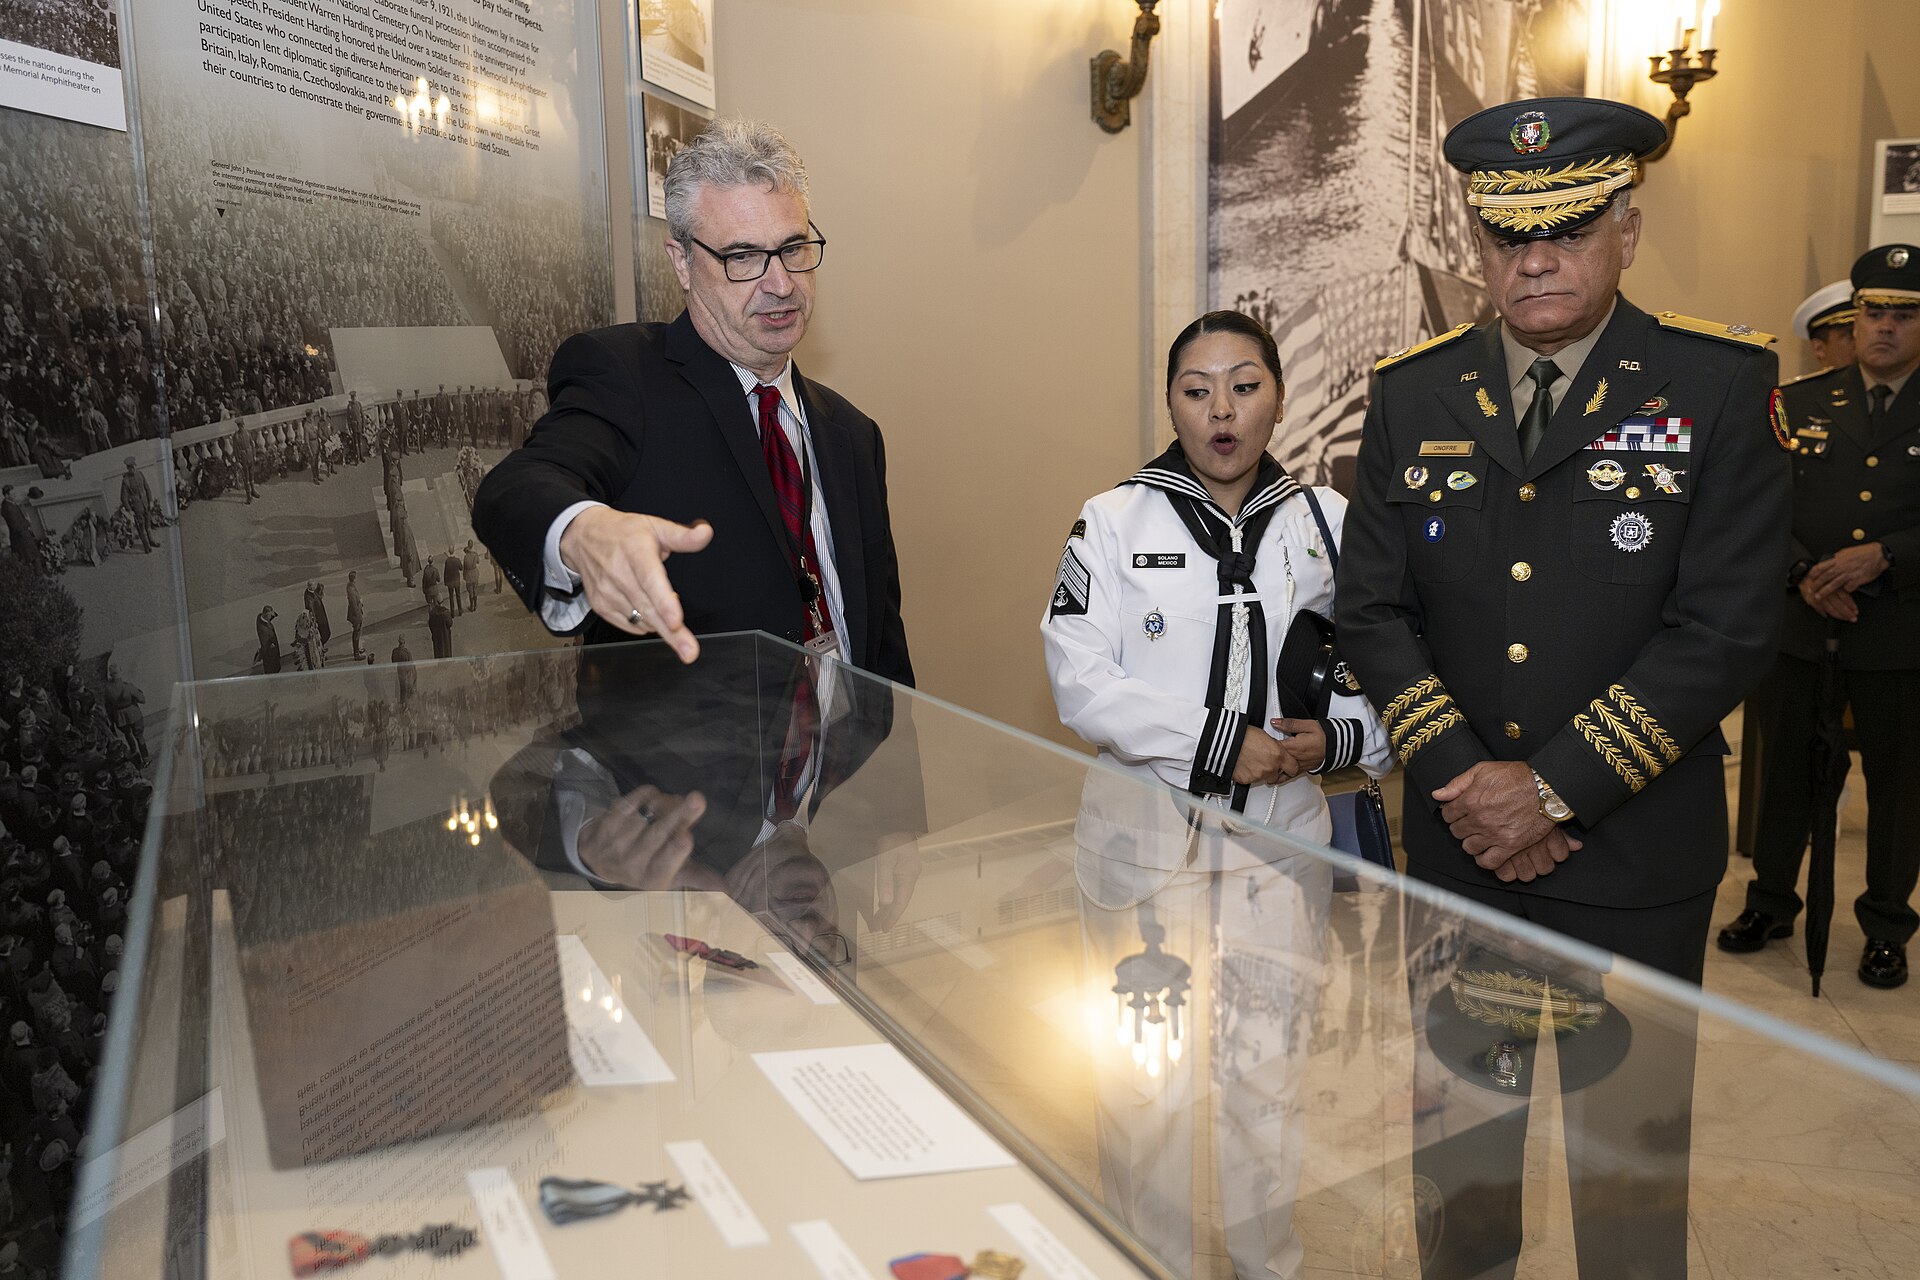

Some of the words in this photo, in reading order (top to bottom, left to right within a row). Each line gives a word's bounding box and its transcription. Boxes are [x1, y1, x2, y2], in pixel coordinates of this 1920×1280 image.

[262, 2, 306, 28] President
[306, 18, 341, 43] Harding
[342, 31, 376, 53] honored
[378, 44, 390, 58] the
[392, 48, 426, 70] Unknown
[428, 60, 452, 80] Soldier
[453, 73, 460, 82] as
[461, 76, 466, 84] a
[308, 1, 341, 22] Warren
[342, 14, 374, 38] Harding
[376, 29, 408, 48] presided
[408, 40, 424, 54] over
[426, 48, 430, 56] a
[431, 50, 448, 62] state
[449, 54, 470, 72] funeral
[472, 64, 478, 74] at
[480, 65, 508, 84] Memorial
[340, 0, 370, 17] National
[372, 9, 411, 34] Cemetery.
[412, 24, 424, 38] On
[425, 30, 462, 52] November
[473, 49, 484, 60] the
[484, 55, 518, 76] anniversary
[519, 67, 527, 77] of
[410, 8, 434, 26] funeral
[436, 20, 471, 40] procession
[472, 34, 486, 46] then
[487, 42, 526, 62] accompanied
[526, 54, 537, 67] the
[438, 3, 456, 20] 1921,
[457, 12, 468, 24] the
[469, 16, 500, 37] Unknown
[500, 29, 508, 43] lay
[509, 34, 516, 43] in
[516, 38, 530, 50] state
[530, 42, 540, 54] for
[482, 0, 494, 12] pay
[496, 4, 512, 18] their
[515, 13, 544, 32] respects.
[4, 64, 40, 80] Memorial
[41, 73, 90, 92] Amphitheater
[18, 56, 30, 66] the
[32, 60, 56, 72] nation
[58, 66, 82, 80] during
[82, 72, 94, 82] the
[198, 0, 232, 20] United
[234, 10, 263, 32] States
[265, 24, 286, 39] who
[288, 32, 333, 54] connected
[335, 46, 348, 60] the
[350, 52, 378, 70] diverse
[380, 61, 414, 82] American
[416, 76, 440, 92] pple
[440, 84, 448, 93] to
[450, 86, 461, 98] the
[200, 22, 261, 49] participation
[263, 39, 280, 56] lent
[283, 46, 328, 70] diplomatic
[330, 62, 374, 84] significance
[376, 78, 384, 88] to
[386, 80, 398, 93] the
[524, 124, 541, 138] Great
[201, 38, 237, 62] Britain,
[238, 50, 260, 70] Italy,
[261, 56, 302, 82] Romania,
[303, 70, 368, 100] Czechoslovakia,
[368, 92, 382, 104] and
[446, 115, 457, 126] the
[458, 118, 490, 137] Unknown
[490, 129, 504, 142] with
[504, 134, 526, 149] medals
[526, 138, 540, 152] from
[203, 60, 226, 76] their
[230, 70, 274, 90] countries
[276, 82, 287, 93] to
[290, 84, 342, 110] demonstrate
[345, 101, 364, 115] their
[416, 124, 448, 140] gratitude
[448, 133, 456, 142] to
[458, 134, 470, 146] the
[470, 138, 490, 152] United
[492, 144, 512, 158] States.
[211, 160, 230, 170] General
[246, 167, 266, 178] Pershing
[288, 177, 304, 186] military
[338, 186, 350, 194] before
[213, 180, 226, 188] Crow
[226, 182, 242, 190] Nation
[274, 191, 284, 200] looks
[222, 172, 244, 182] interment
[294, 186, 312, 195] National
